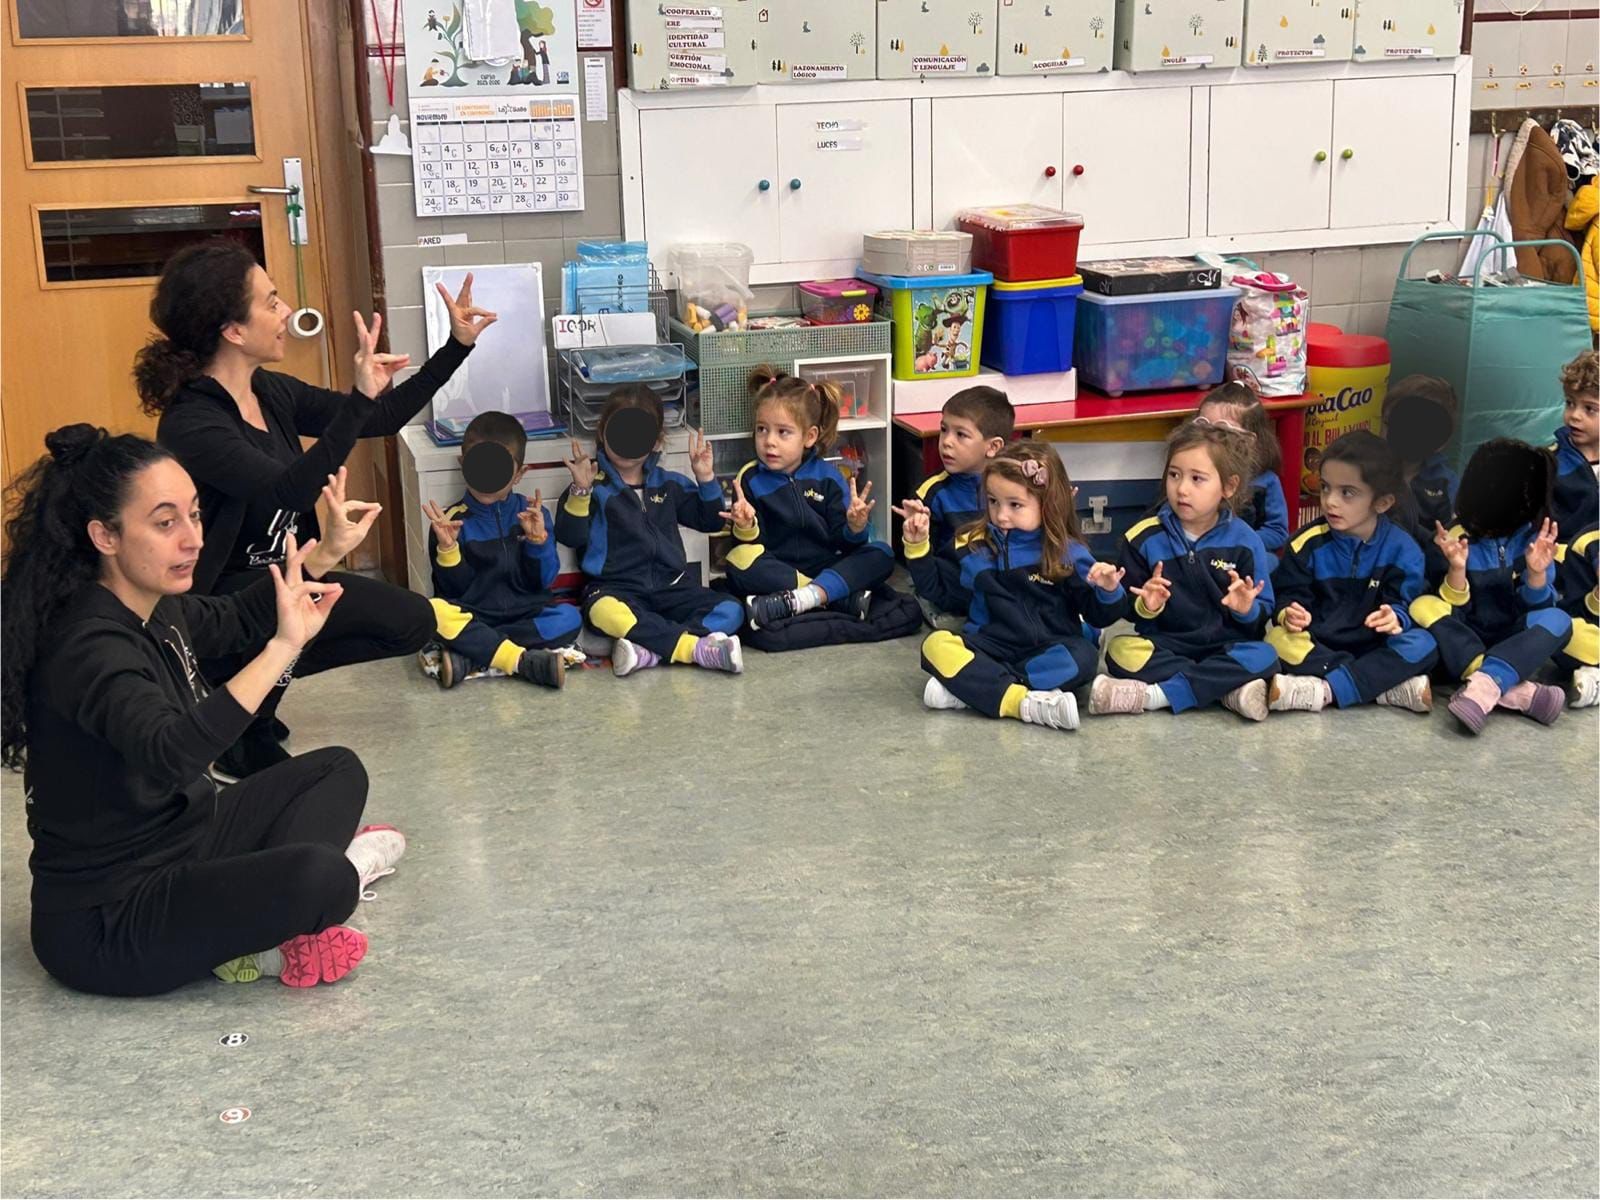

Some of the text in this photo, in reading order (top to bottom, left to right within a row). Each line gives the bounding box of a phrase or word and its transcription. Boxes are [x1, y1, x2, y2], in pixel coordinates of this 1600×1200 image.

[666, 8, 714, 16] COOPERATIV
[668, 33, 709, 41] IDENTIDAD
[670, 61, 712, 70] EMOCIONAL
[555, 124, 562, 133] 2
[444, 145, 450, 153] 4
[466, 144, 473, 153] 5
[489, 143, 496, 152] 6
[511, 143, 517, 151] 7
[534, 142, 541, 150] 8
[816, 140, 838, 149] LUCES
[422, 159, 566, 172] 10 11 12 13 14 15 16
[423, 176, 568, 189] 17 18 19 20 21 22 23
[424, 193, 569, 206] 24 25 26 27 28 29 30
[1307, 386, 1373, 416] olaCao
